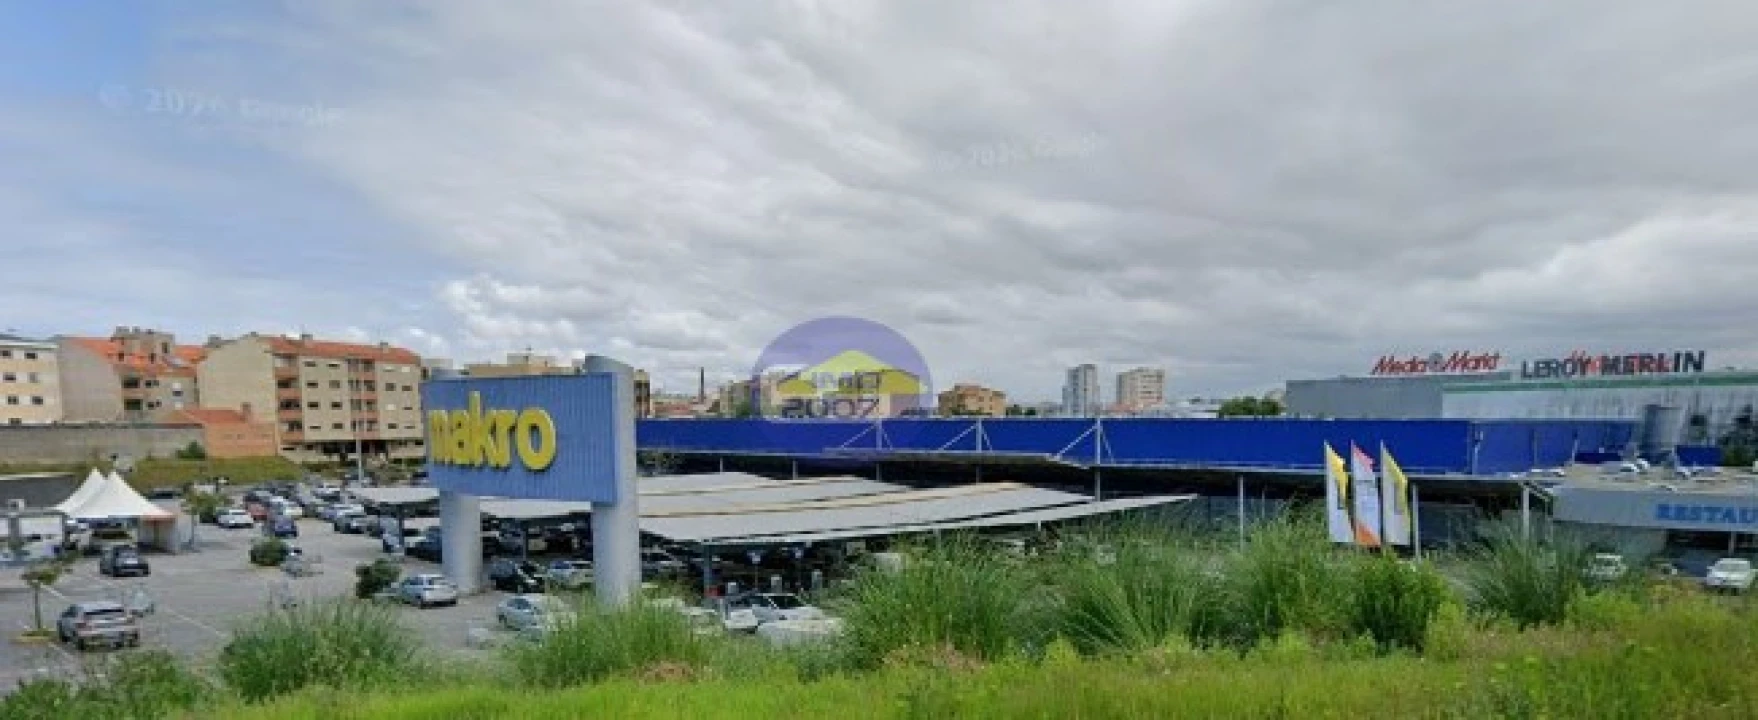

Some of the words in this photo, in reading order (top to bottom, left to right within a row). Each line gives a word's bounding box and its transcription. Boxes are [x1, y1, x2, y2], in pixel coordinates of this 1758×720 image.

[1371, 355, 1427, 375] Media
[1442, 350, 1501, 371] Markt
[1521, 354, 1594, 379] LEROY
[1602, 350, 1705, 375] MERLIN
[429, 391, 557, 471] makro
